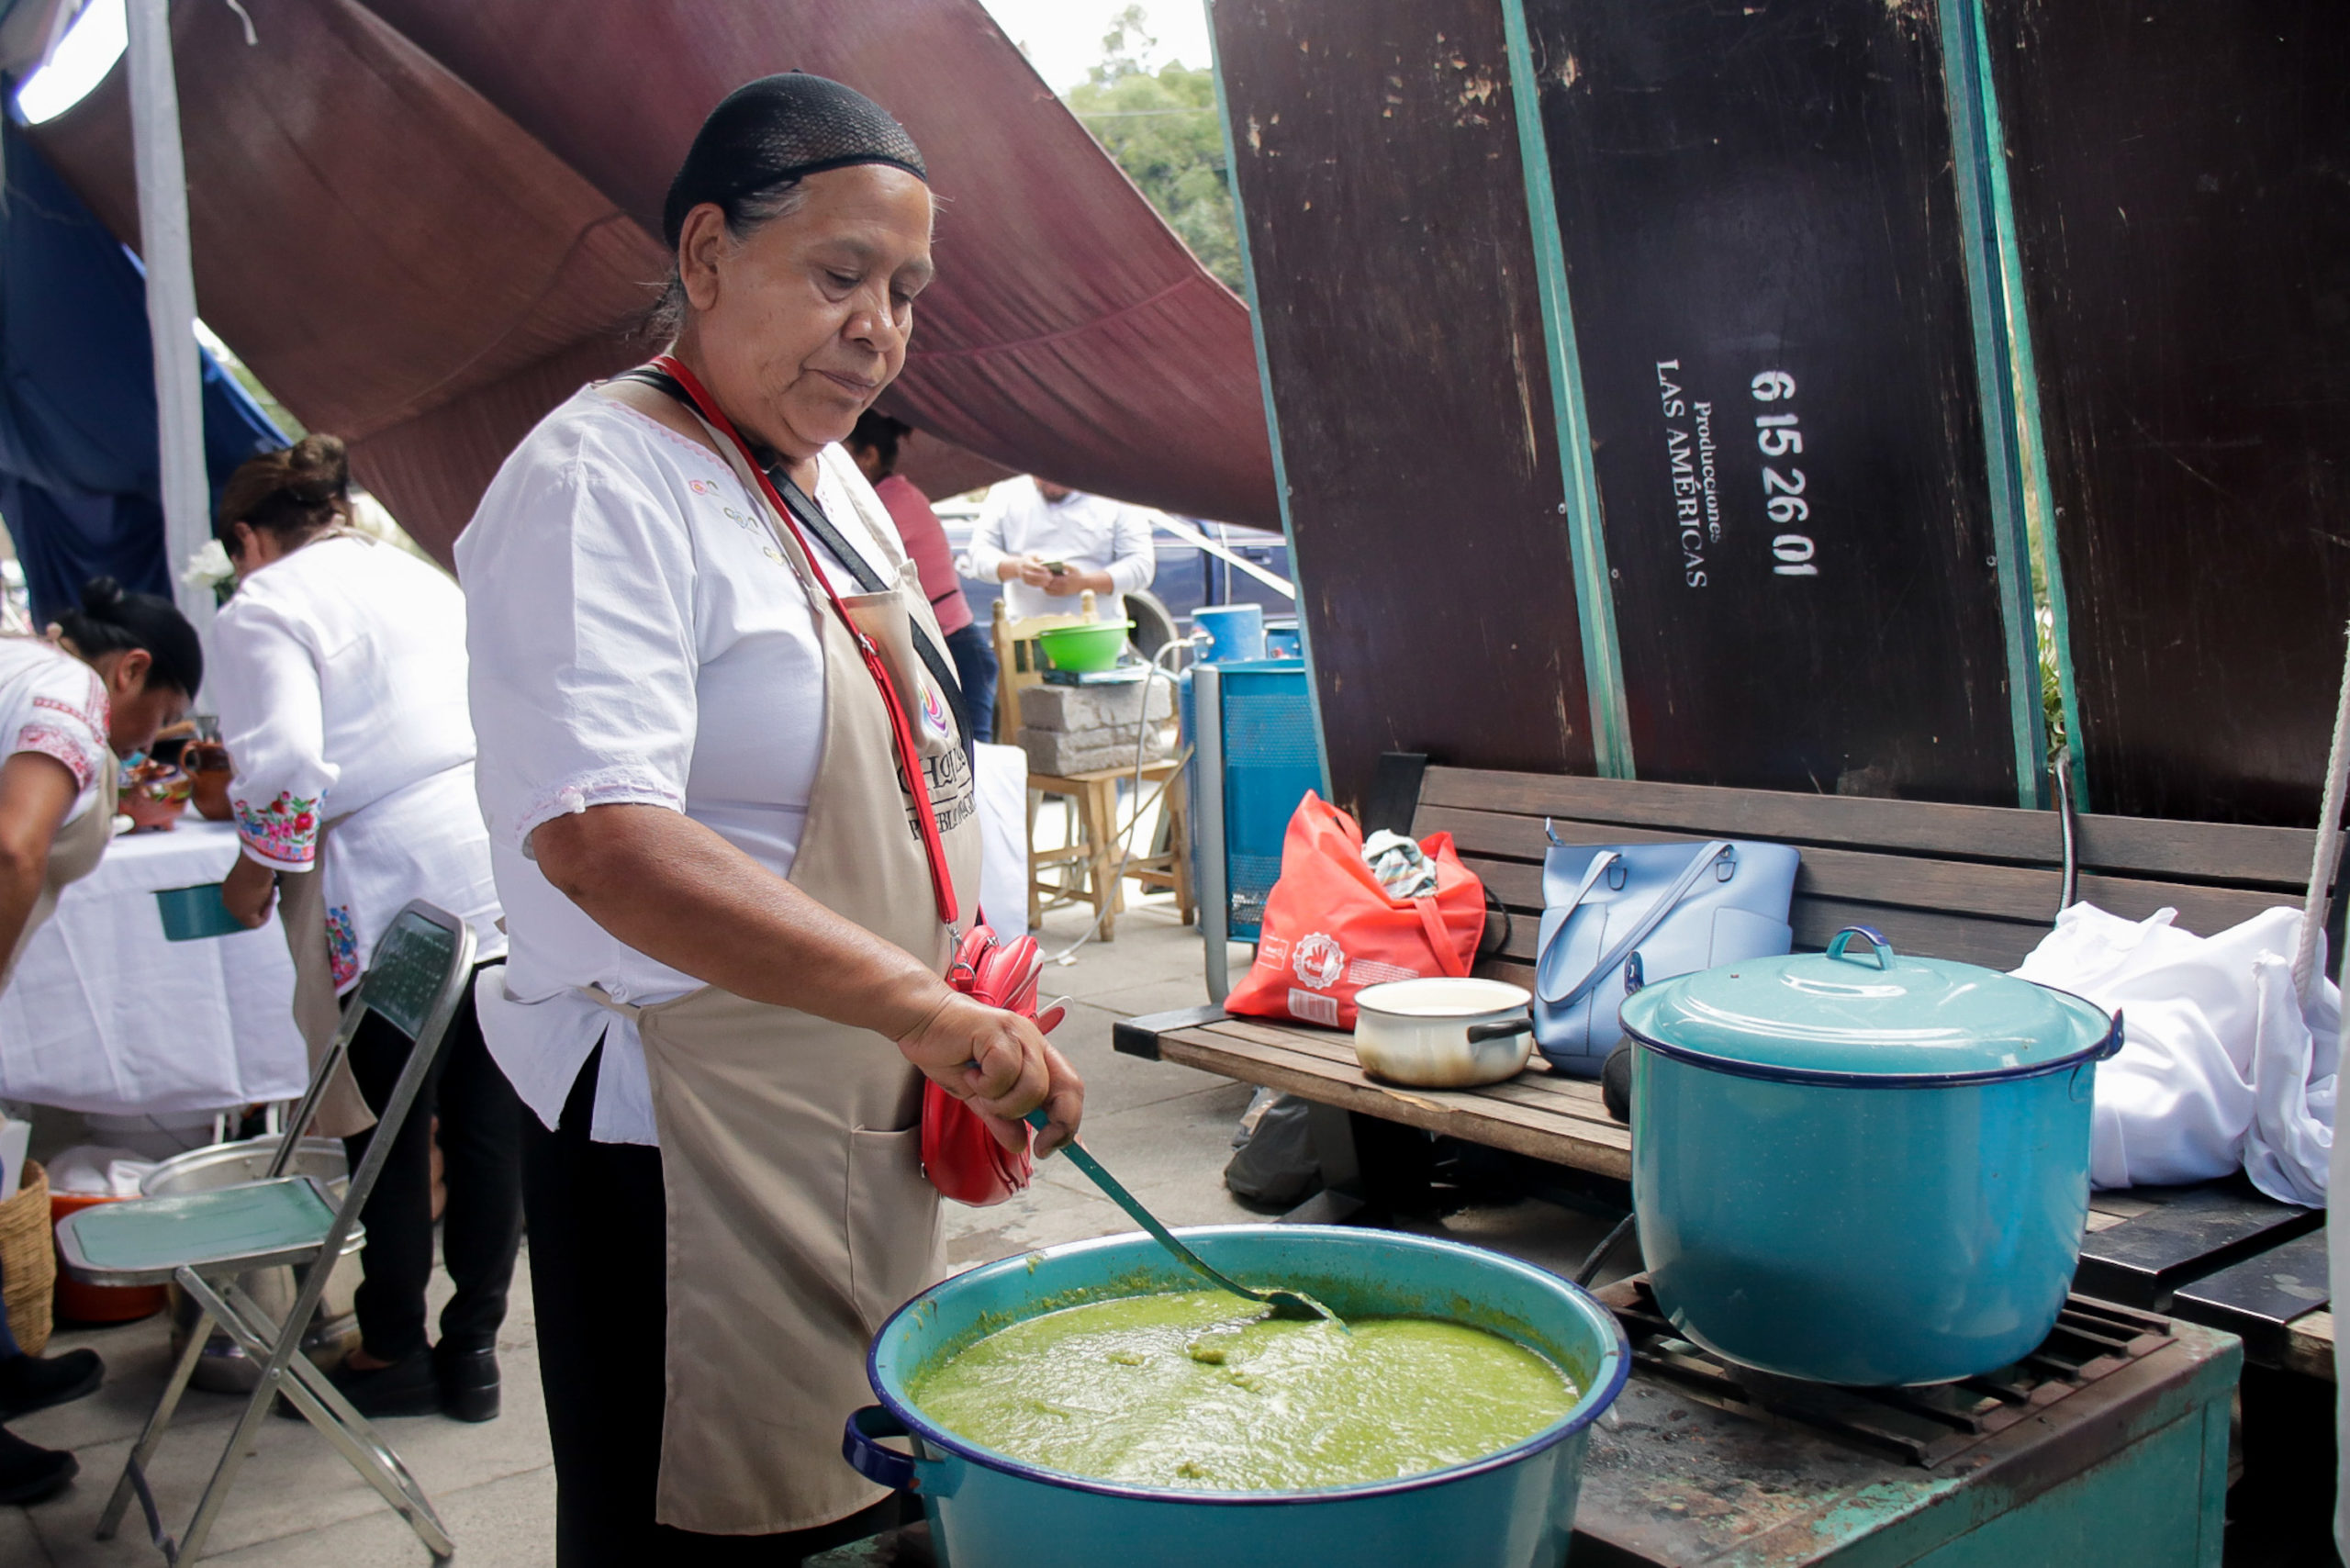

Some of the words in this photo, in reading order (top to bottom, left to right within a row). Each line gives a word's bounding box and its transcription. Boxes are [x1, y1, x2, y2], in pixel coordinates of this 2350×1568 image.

[1655, 358, 1685, 419] LAS
[1751, 370, 1796, 402] 6
[1755, 413, 1804, 457] 15
[1693, 401, 1722, 544] Producciones
[1762, 466, 1809, 523] 26
[1666, 427, 1708, 588] AMÉRICAS
[1772, 534, 1819, 577] 01
